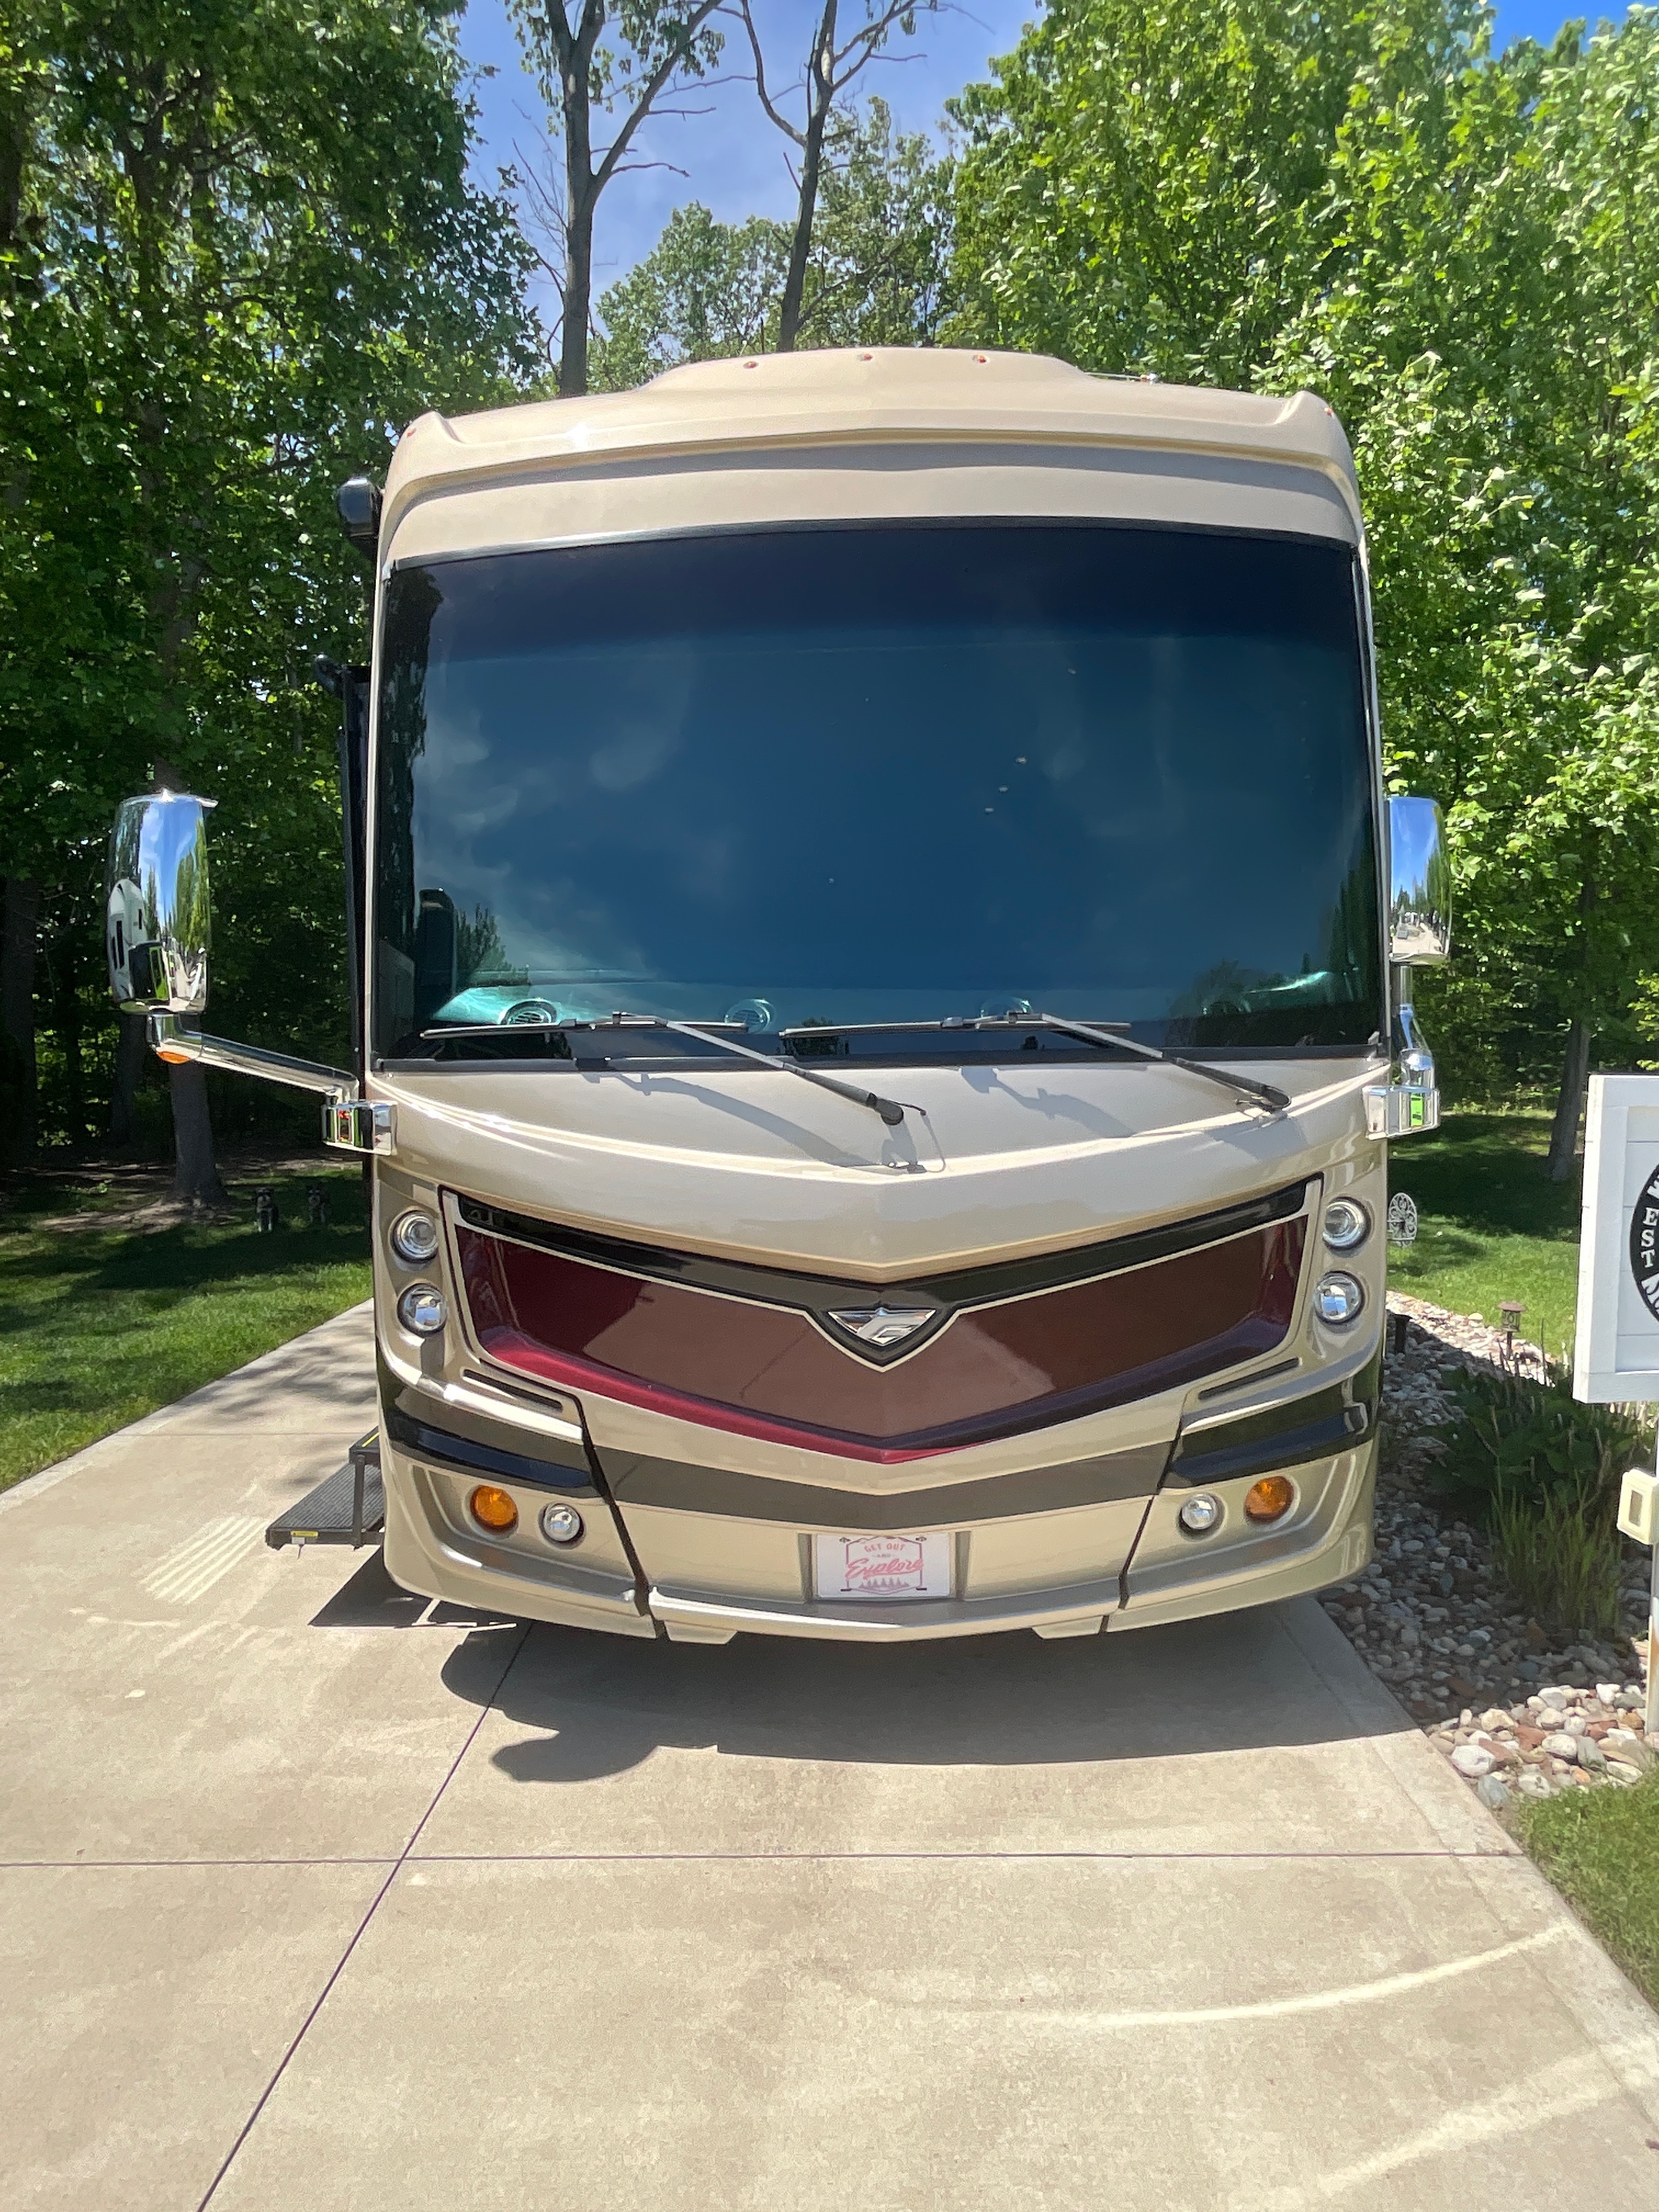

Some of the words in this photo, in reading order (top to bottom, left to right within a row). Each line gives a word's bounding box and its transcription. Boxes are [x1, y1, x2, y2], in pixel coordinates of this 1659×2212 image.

[1640, 1207, 1659, 1267] EST
[864, 1543, 881, 1552] GET
[887, 1543, 905, 1551] OUT
[845, 1558, 923, 1579] Explore
